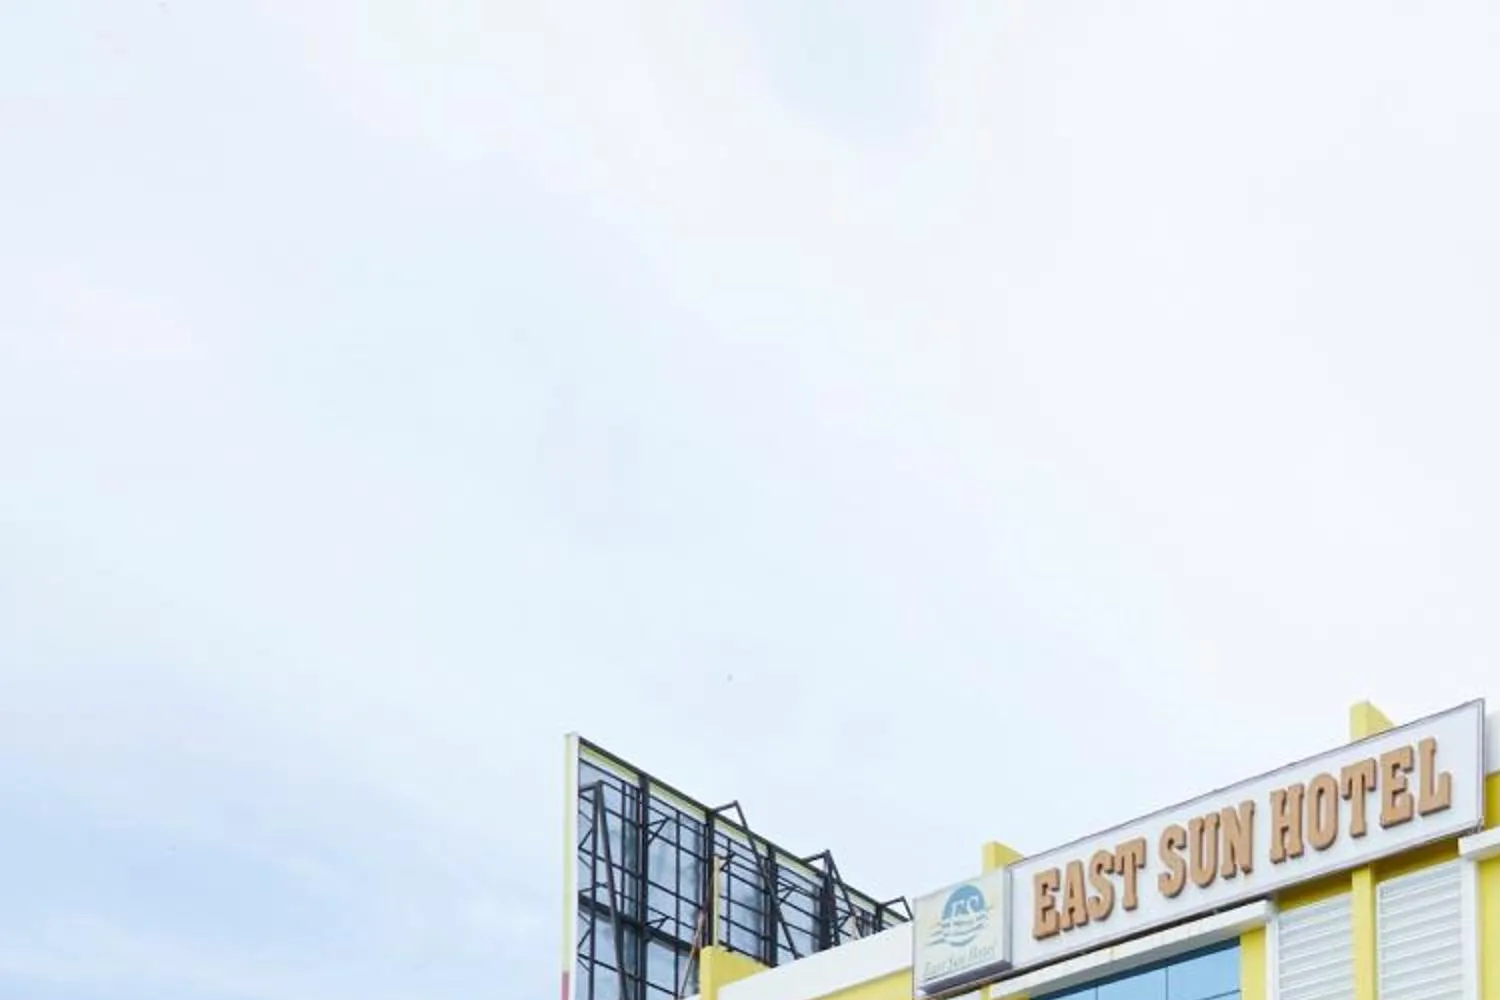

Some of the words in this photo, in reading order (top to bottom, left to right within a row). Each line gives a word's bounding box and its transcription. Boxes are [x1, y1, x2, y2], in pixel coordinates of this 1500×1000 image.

[1032, 837, 1146, 941] EAST
[1157, 800, 1255, 899] SUN
[1269, 737, 1452, 864] HOTEL
